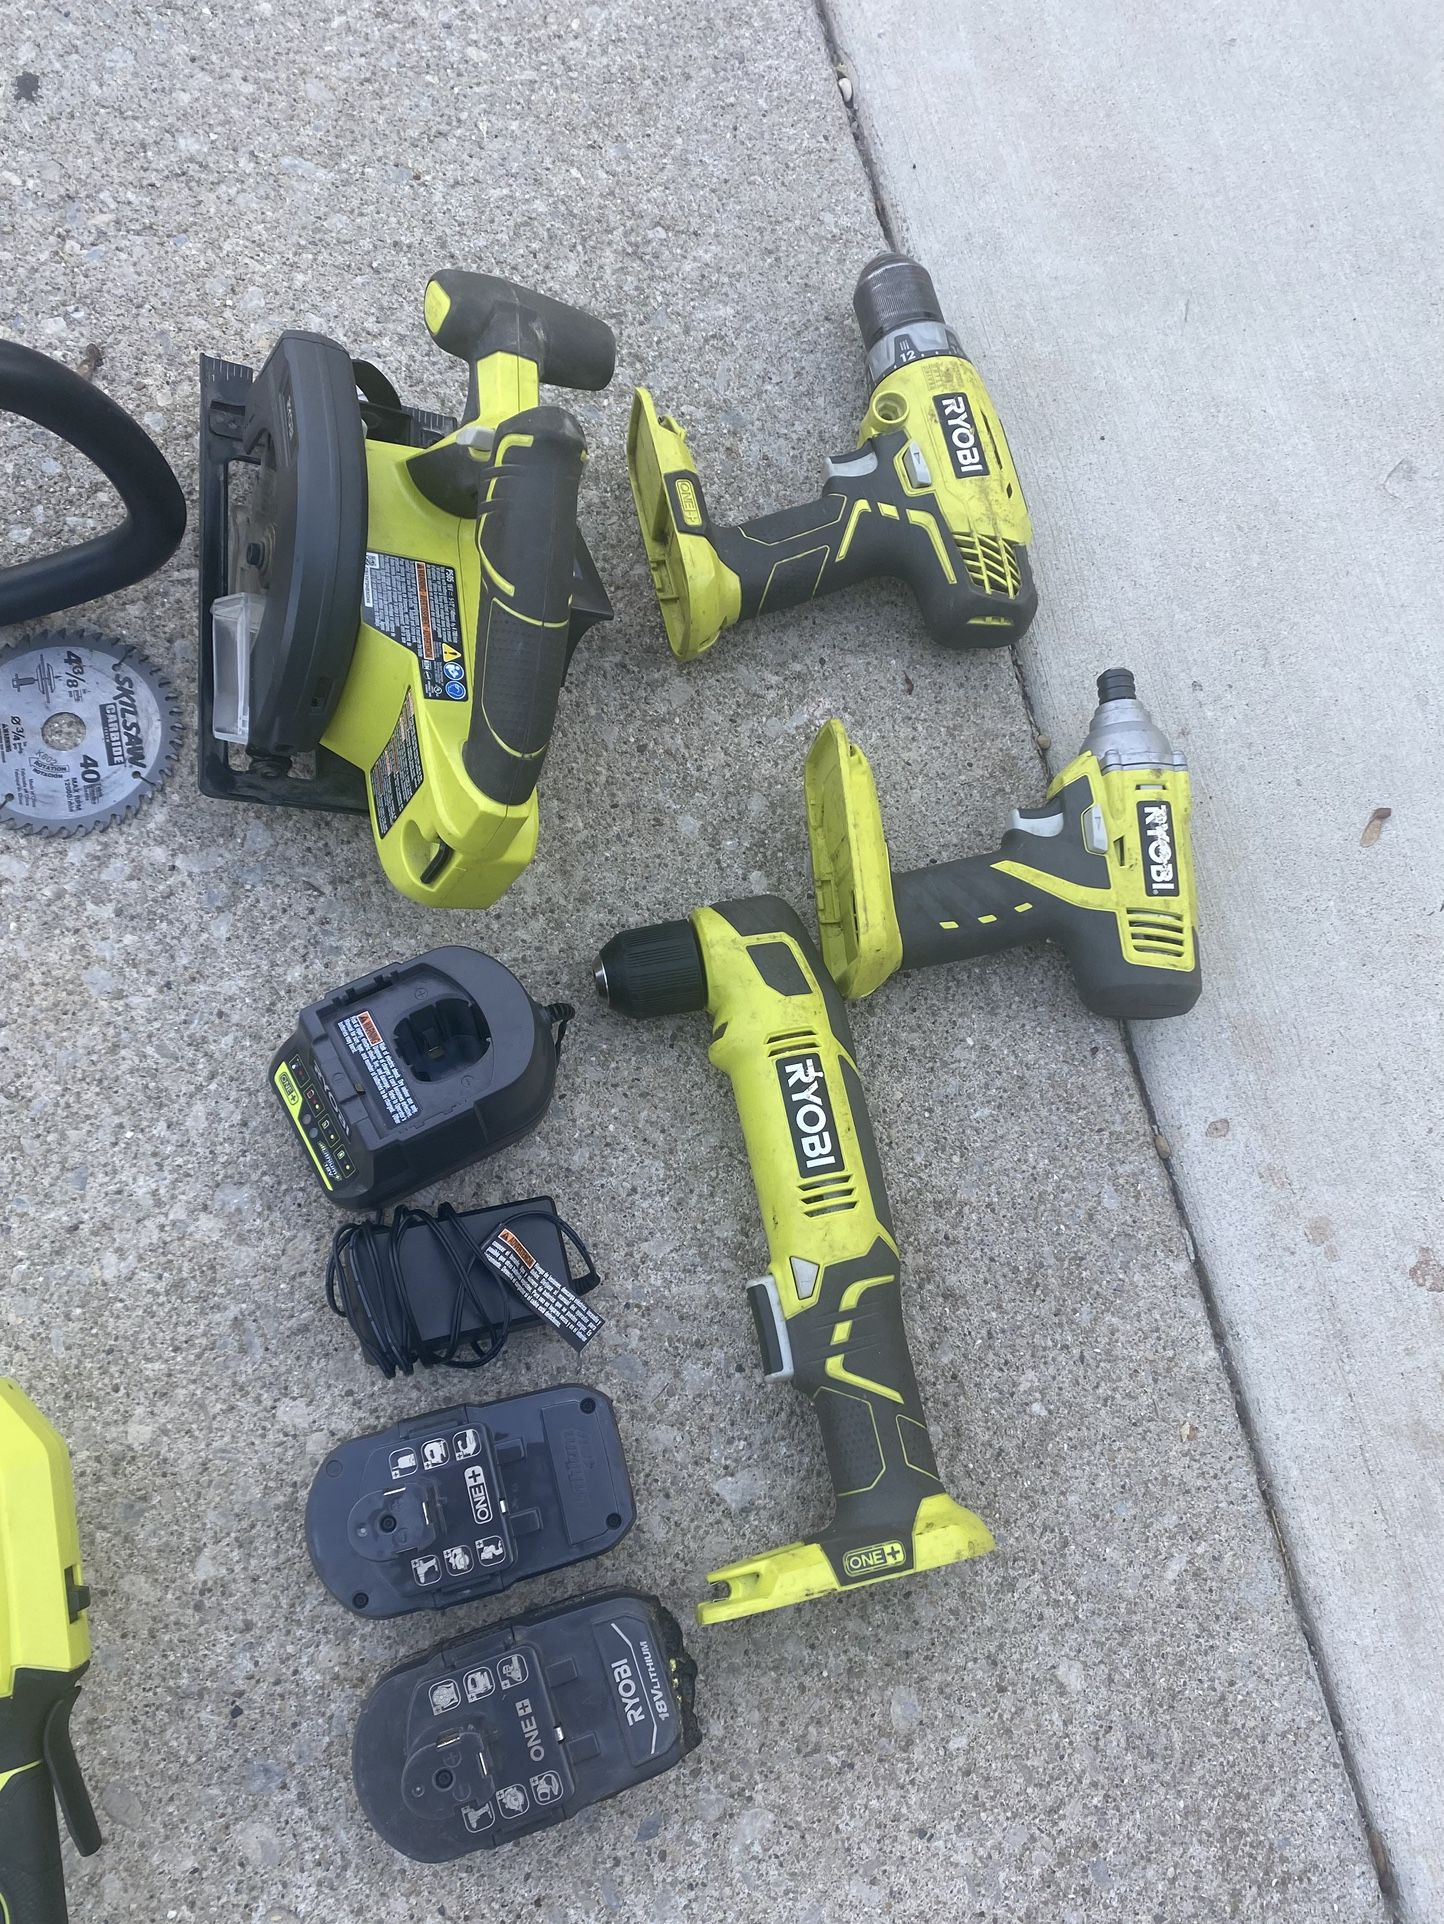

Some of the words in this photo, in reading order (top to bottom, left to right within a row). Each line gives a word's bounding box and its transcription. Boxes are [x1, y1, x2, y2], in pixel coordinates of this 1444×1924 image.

[900, 350, 916, 362] 12
[942, 396, 984, 473] RYOBI
[105, 703, 125, 765] CARBIDE
[113, 673, 147, 769] SKILSAW
[33, 760, 66, 771] ROTATION
[80, 754, 101, 784] 40
[1143, 804, 1175, 890] RYOBI
[313, 1059, 352, 1136] RYOBI
[785, 1058, 836, 1168] RYOBI
[611, 1658, 646, 1726] RYOBI
